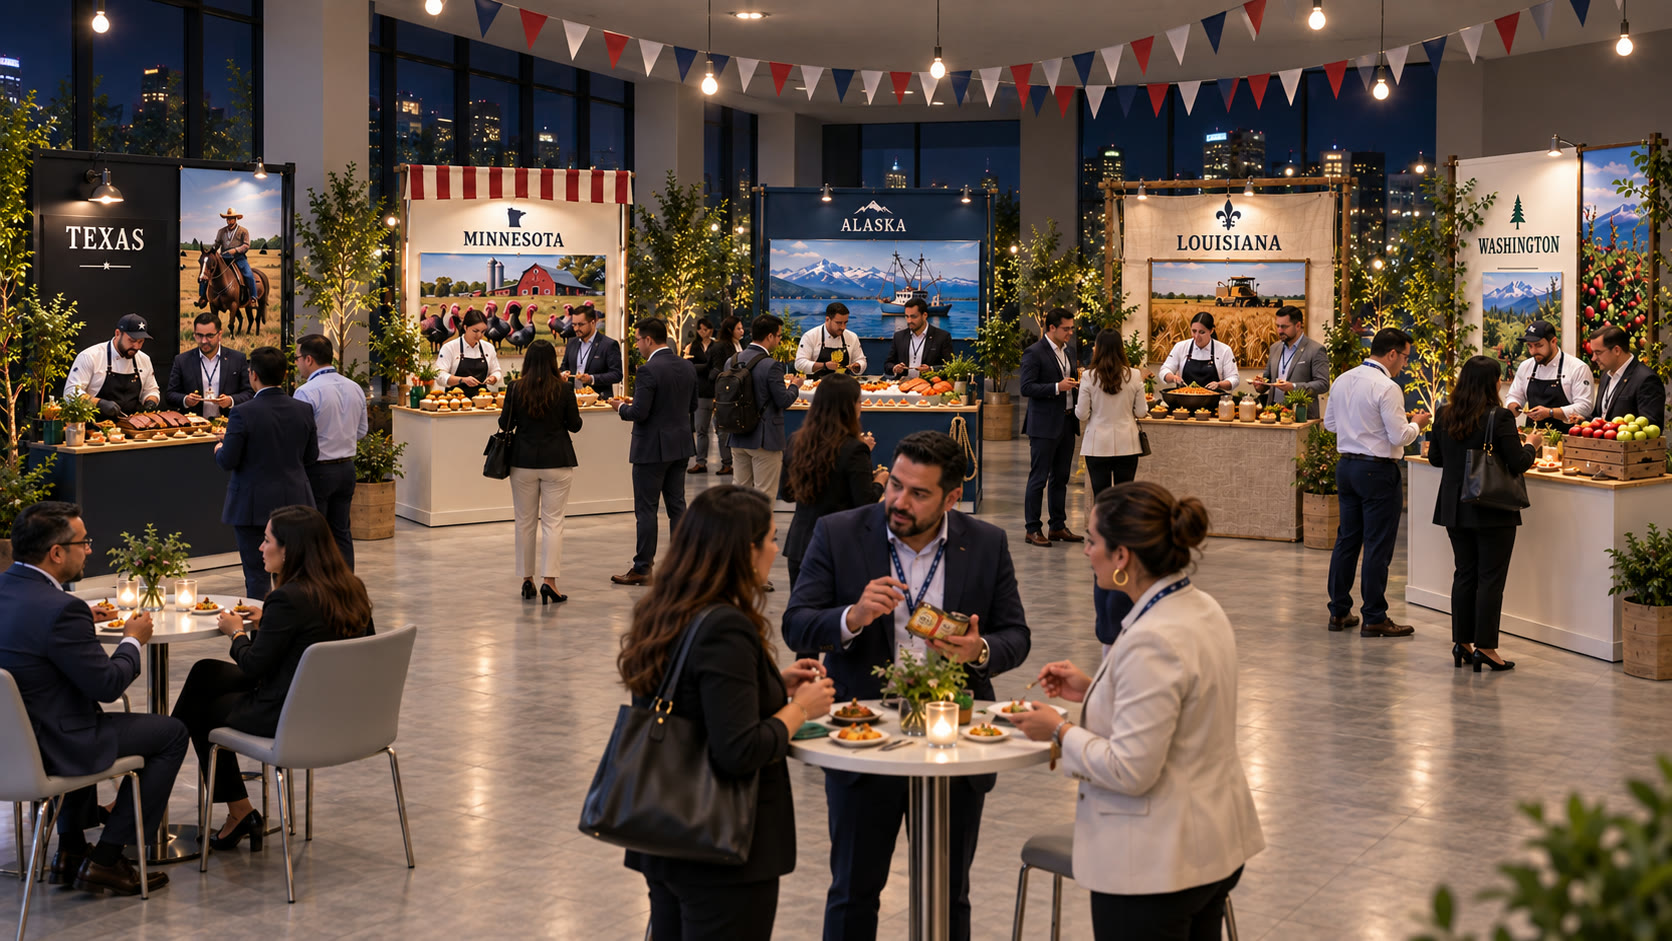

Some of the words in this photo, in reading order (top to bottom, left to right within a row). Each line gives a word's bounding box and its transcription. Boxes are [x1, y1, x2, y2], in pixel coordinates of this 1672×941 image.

[840, 218, 906, 232] ALASKA
[65, 225, 144, 251] TEXAS
[463, 231, 564, 247] MINNESOTA
[1176, 234, 1282, 251] LOUISIANA
[1478, 235, 1559, 254] WASHINGTON
